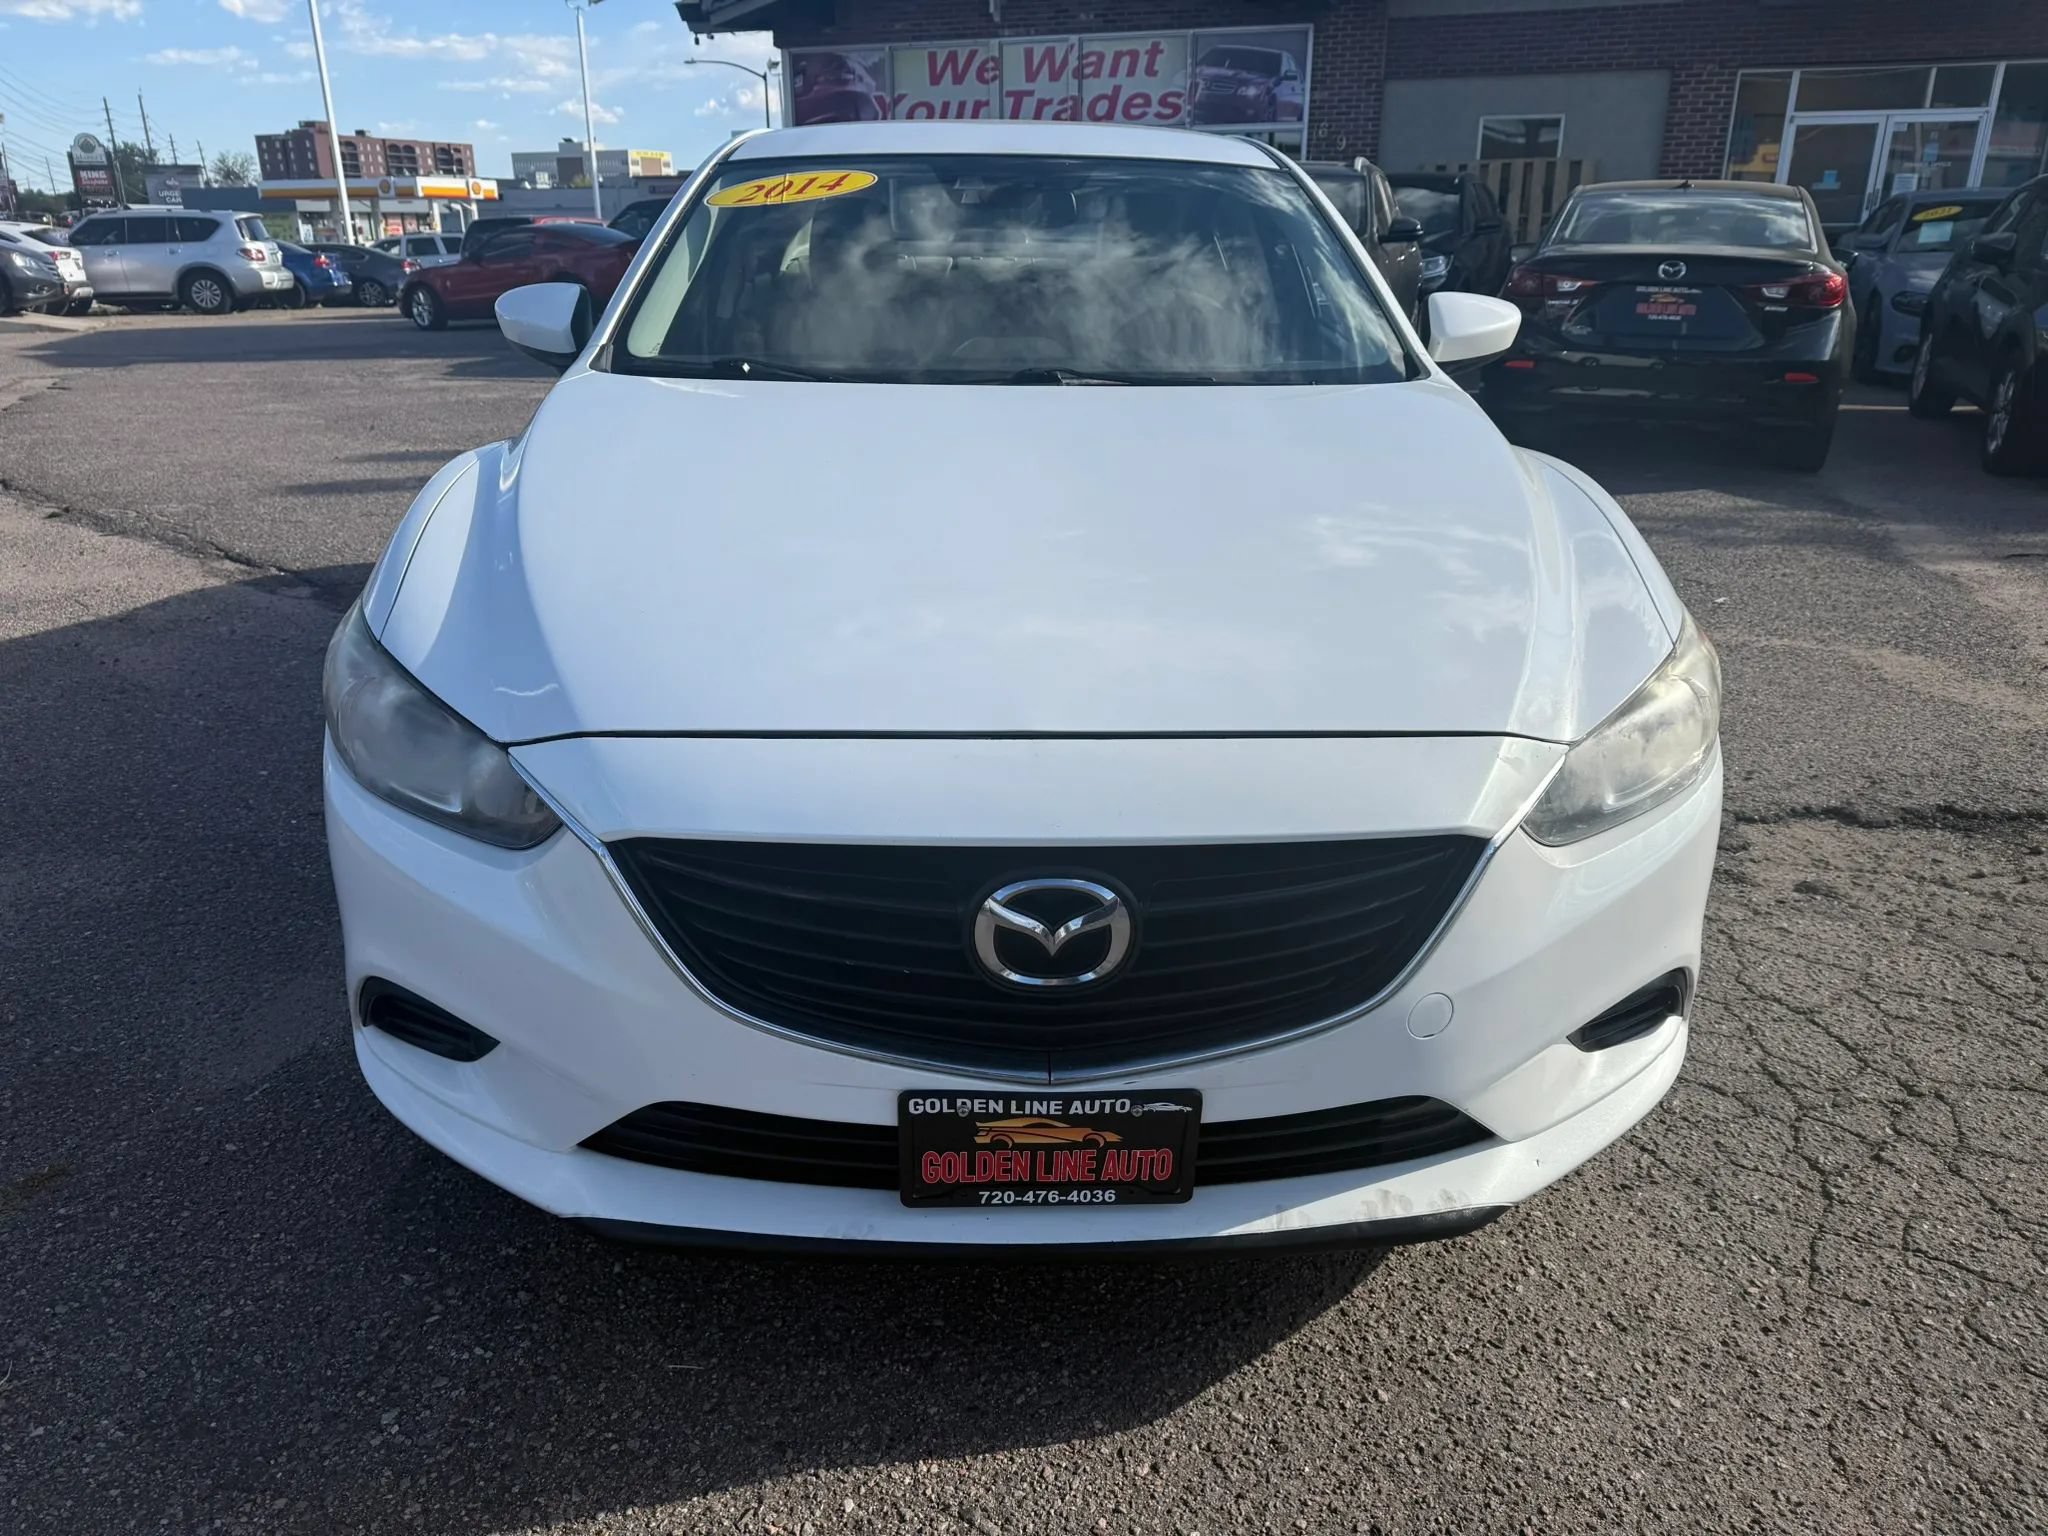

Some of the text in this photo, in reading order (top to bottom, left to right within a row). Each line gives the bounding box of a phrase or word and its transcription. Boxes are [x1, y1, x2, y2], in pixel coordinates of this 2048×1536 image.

[927, 41, 1164, 87] We Want
[873, 93, 990, 120] Your
[734, 173, 851, 204] 2014
[908, 1098, 1131, 1115] GOLDEN LINE AUTO
[921, 1148, 1174, 1184] GOLDEN LINE AUTO
[978, 1190, 1116, 1204] 720-476-4036
